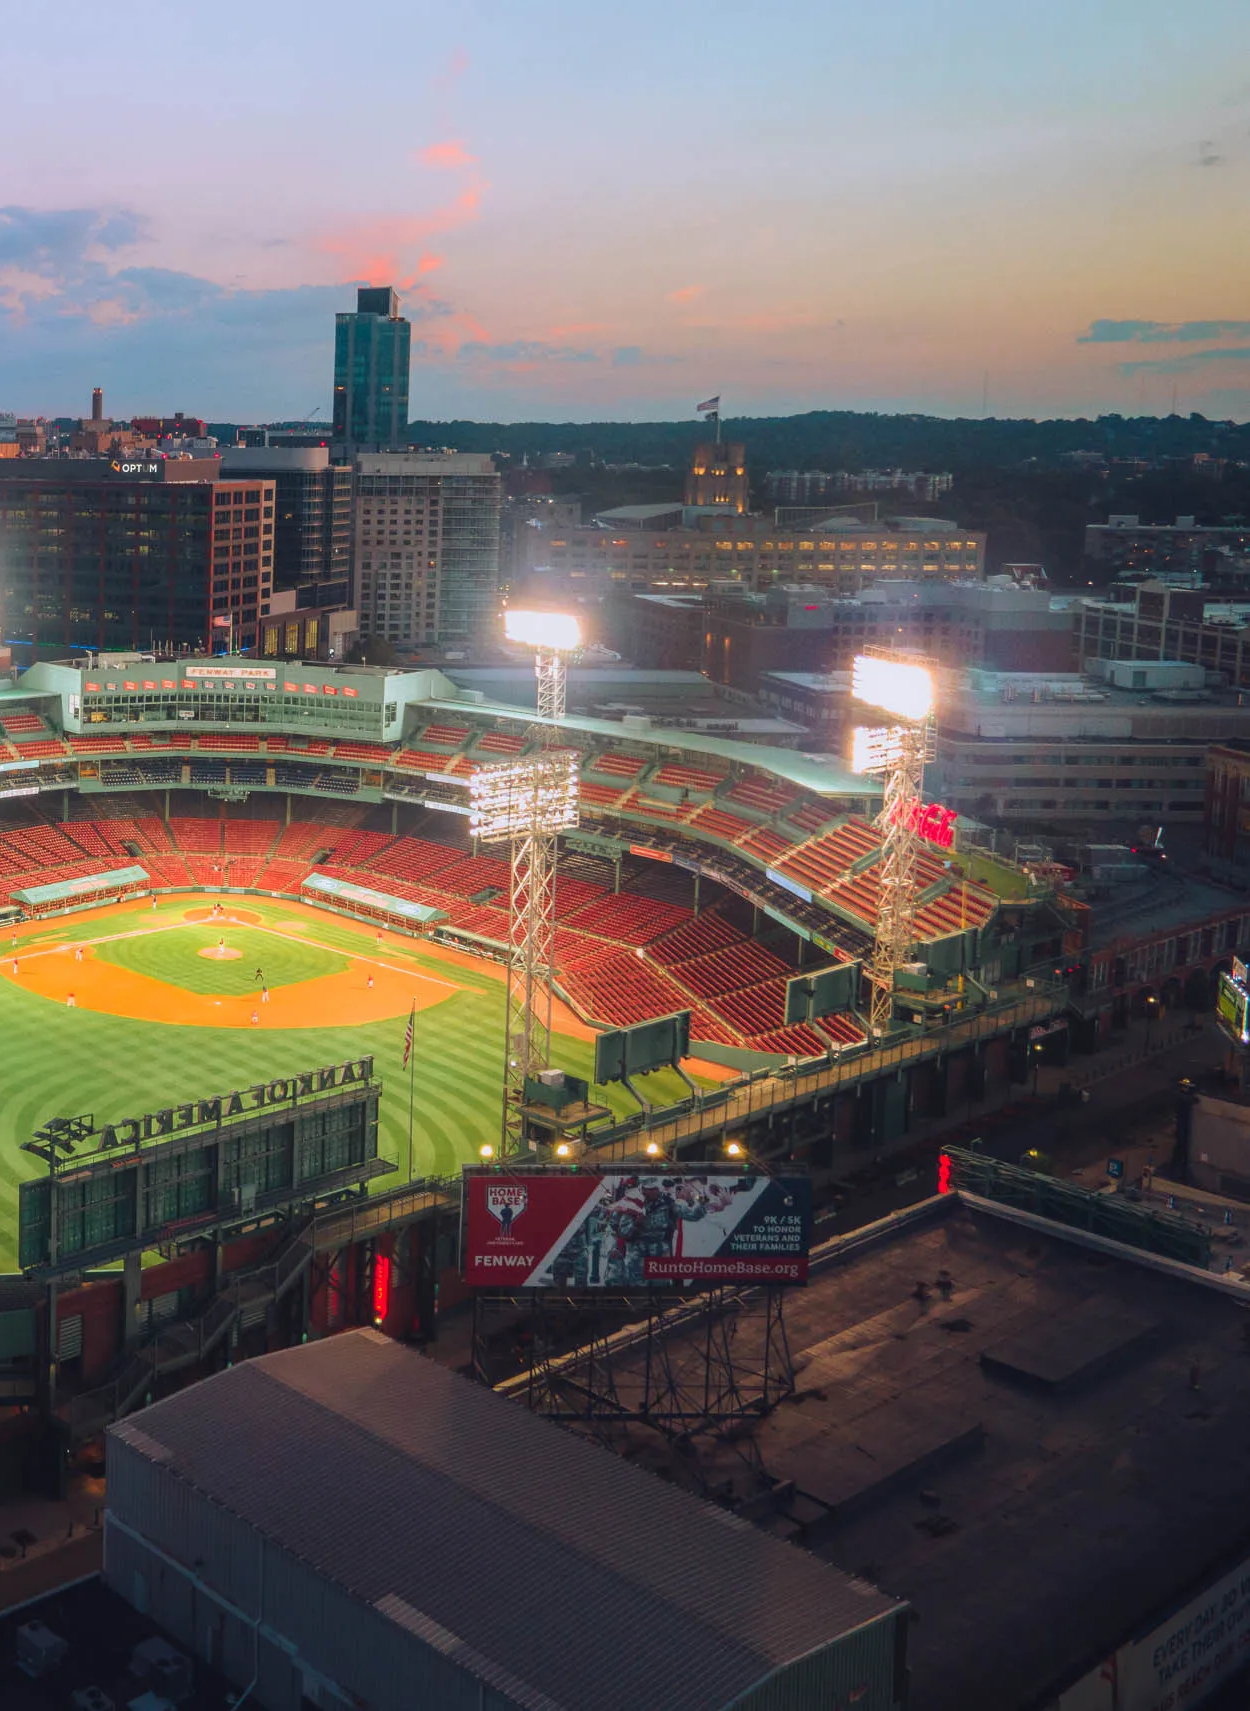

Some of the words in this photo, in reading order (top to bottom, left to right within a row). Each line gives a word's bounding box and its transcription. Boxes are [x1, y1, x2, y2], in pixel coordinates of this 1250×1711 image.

[122, 463, 157, 473] OPTUM
[191, 668, 235, 677] FENWAY
[241, 669, 270, 677] PARK
[489, 1188, 523, 1197] HOME
[492, 1197, 520, 1206] BASE
[763, 1216, 778, 1225] 9K
[788, 1216, 801, 1225] 5K
[734, 1234, 779, 1242] VETERANS
[781, 1234, 800, 1242] AND
[730, 1243, 756, 1251] THEIR
[759, 1243, 800, 1251] FAMILIES
[474, 1255, 535, 1267] FENWAY
[648, 1261, 799, 1278] RuntoHomeBase.org
[1153, 1621, 1192, 1668] EVERY
[1193, 1602, 1217, 1634] DAY
[1158, 1652, 1188, 1687] TAKE
